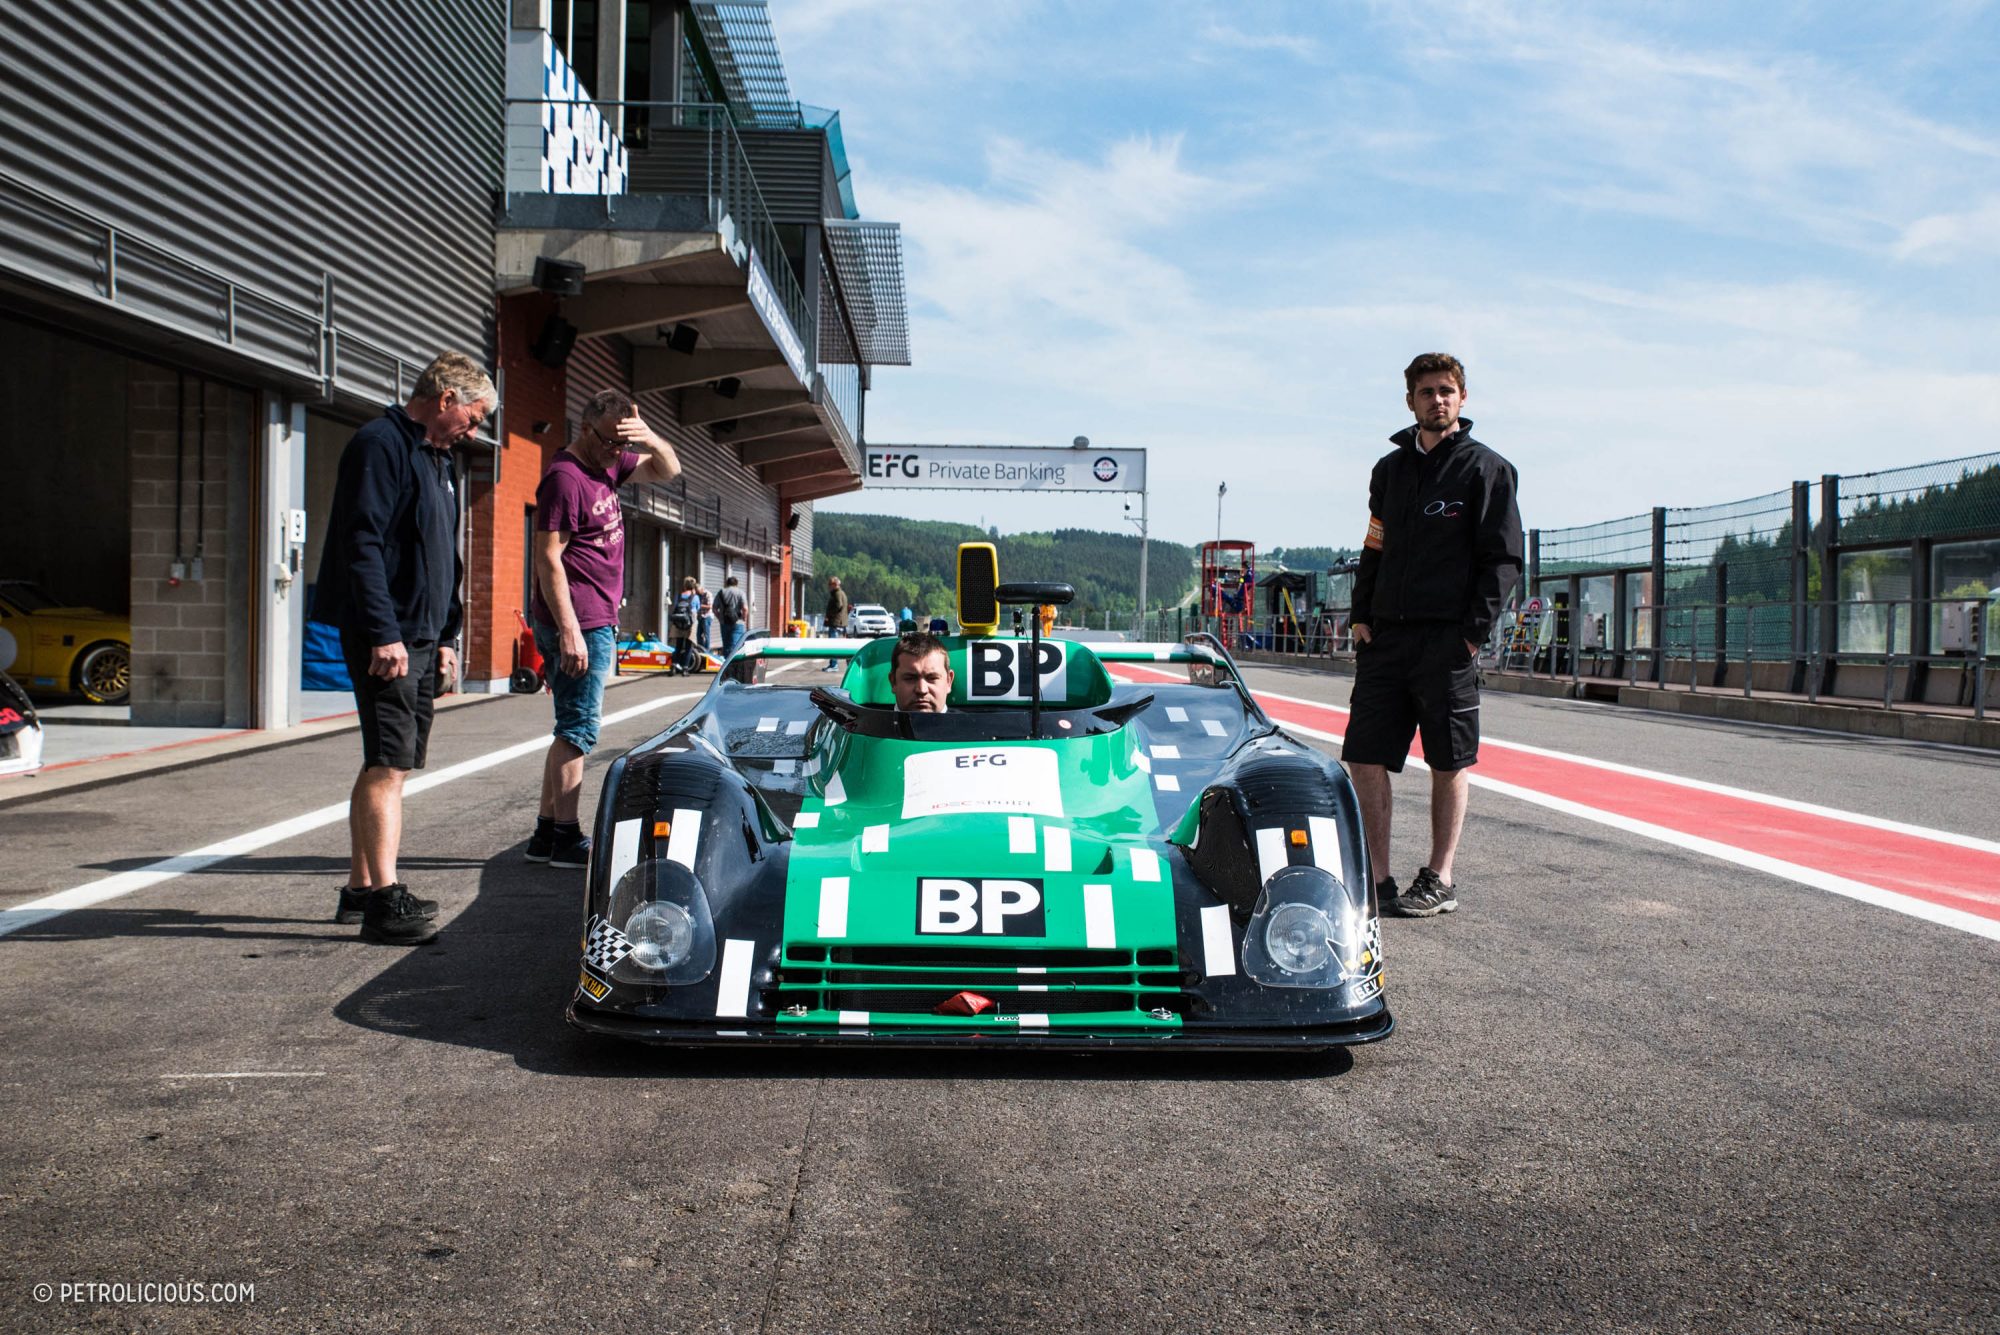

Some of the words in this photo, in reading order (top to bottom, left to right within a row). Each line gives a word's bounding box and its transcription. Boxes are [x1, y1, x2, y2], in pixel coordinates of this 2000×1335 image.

[868, 454, 920, 478] EFG
[929, 461, 991, 480] Private
[995, 461, 1066, 484] Banking
[972, 642, 1062, 697] BP
[955, 754, 1007, 768] EFG
[921, 879, 1041, 934] BP
